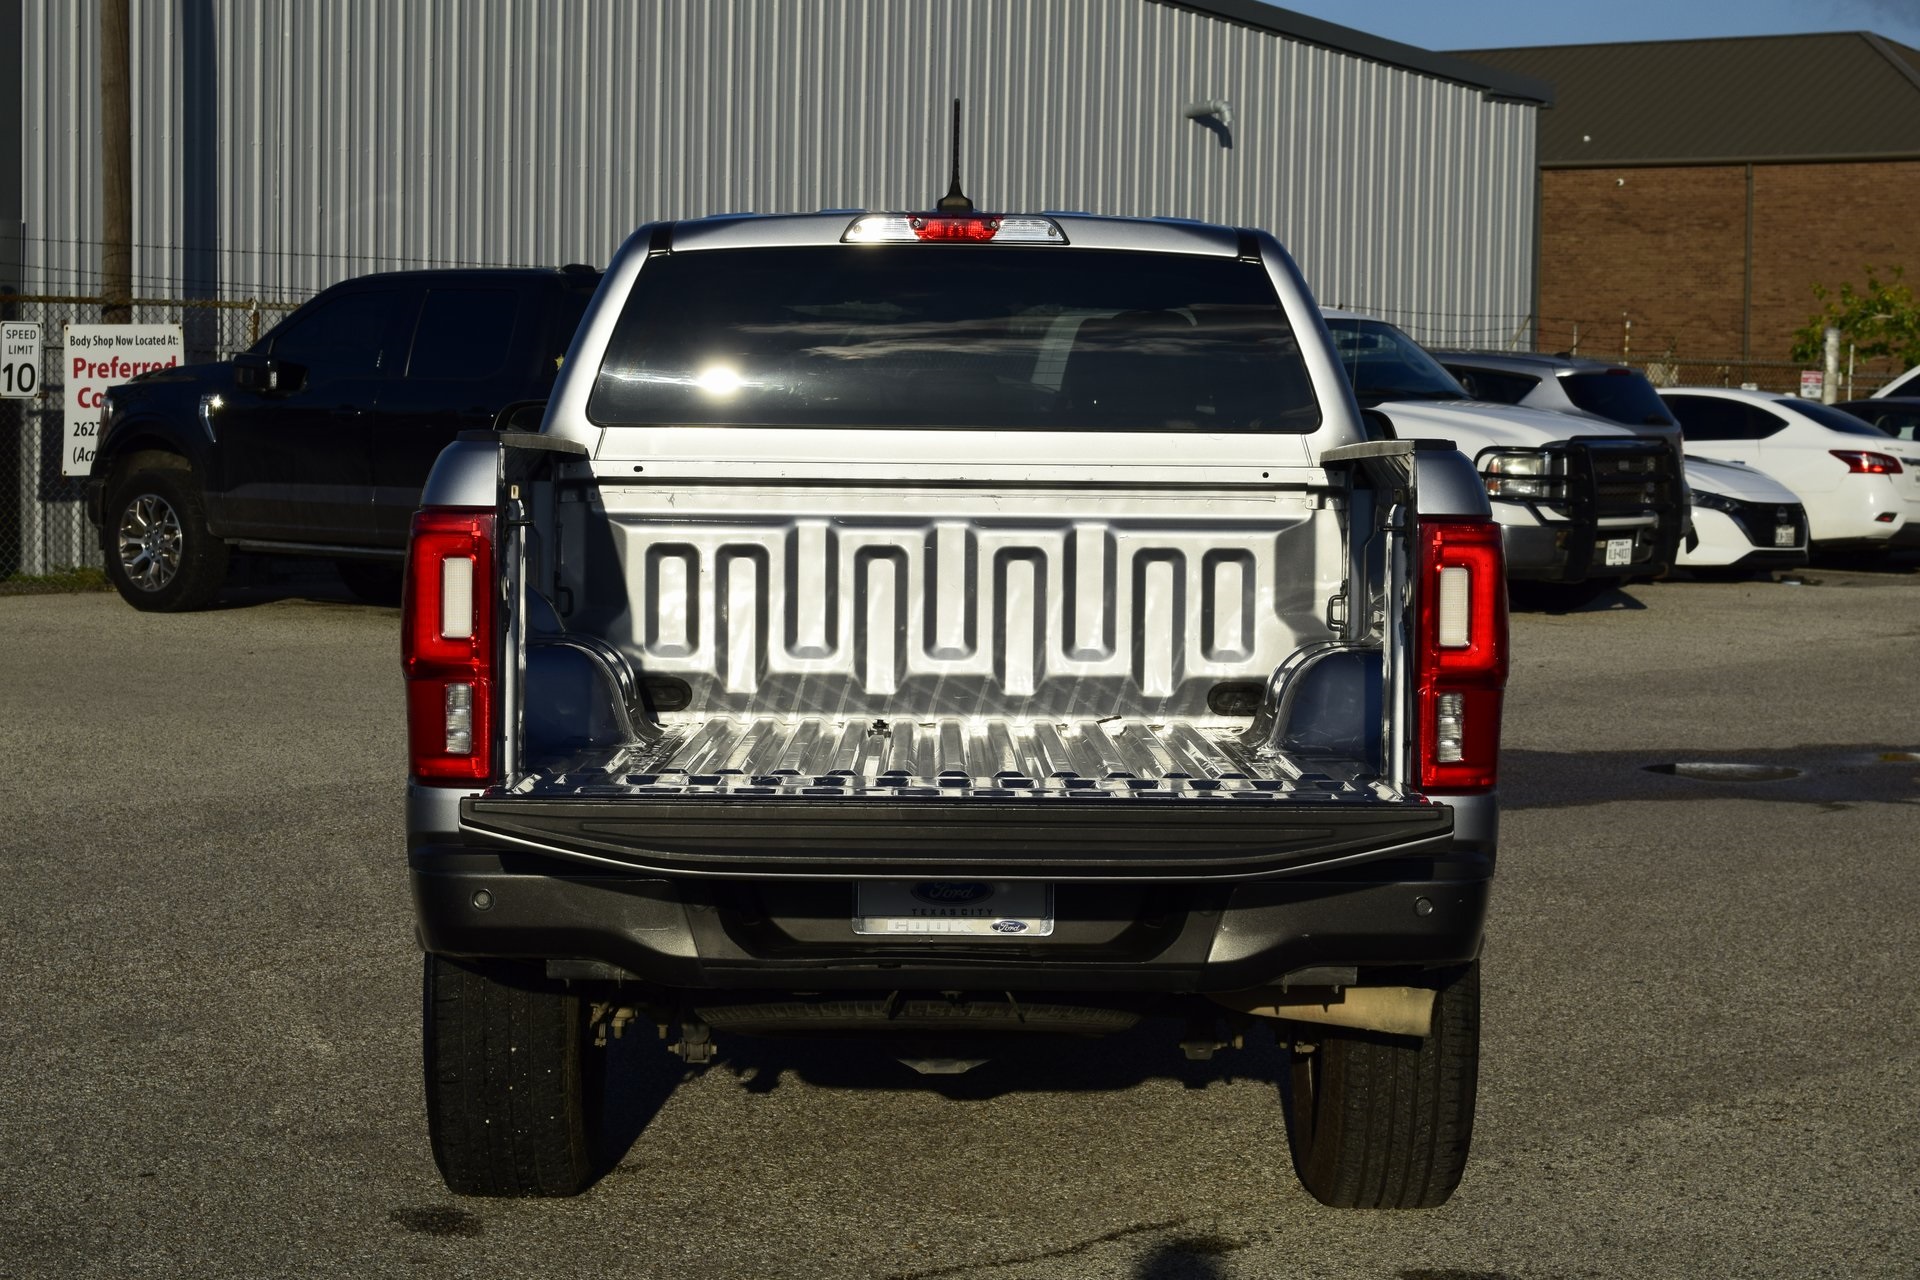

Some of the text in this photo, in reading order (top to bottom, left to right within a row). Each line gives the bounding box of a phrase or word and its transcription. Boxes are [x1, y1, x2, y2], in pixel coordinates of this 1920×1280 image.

[6, 329, 37, 340] SPEED
[70, 335, 179, 349] Body Shop Now Located At:
[8, 345, 34, 355] LIMIT
[2, 362, 36, 393] 10
[929, 881, 975, 899] Ford
[911, 908, 993, 916] TEXAS CITY
